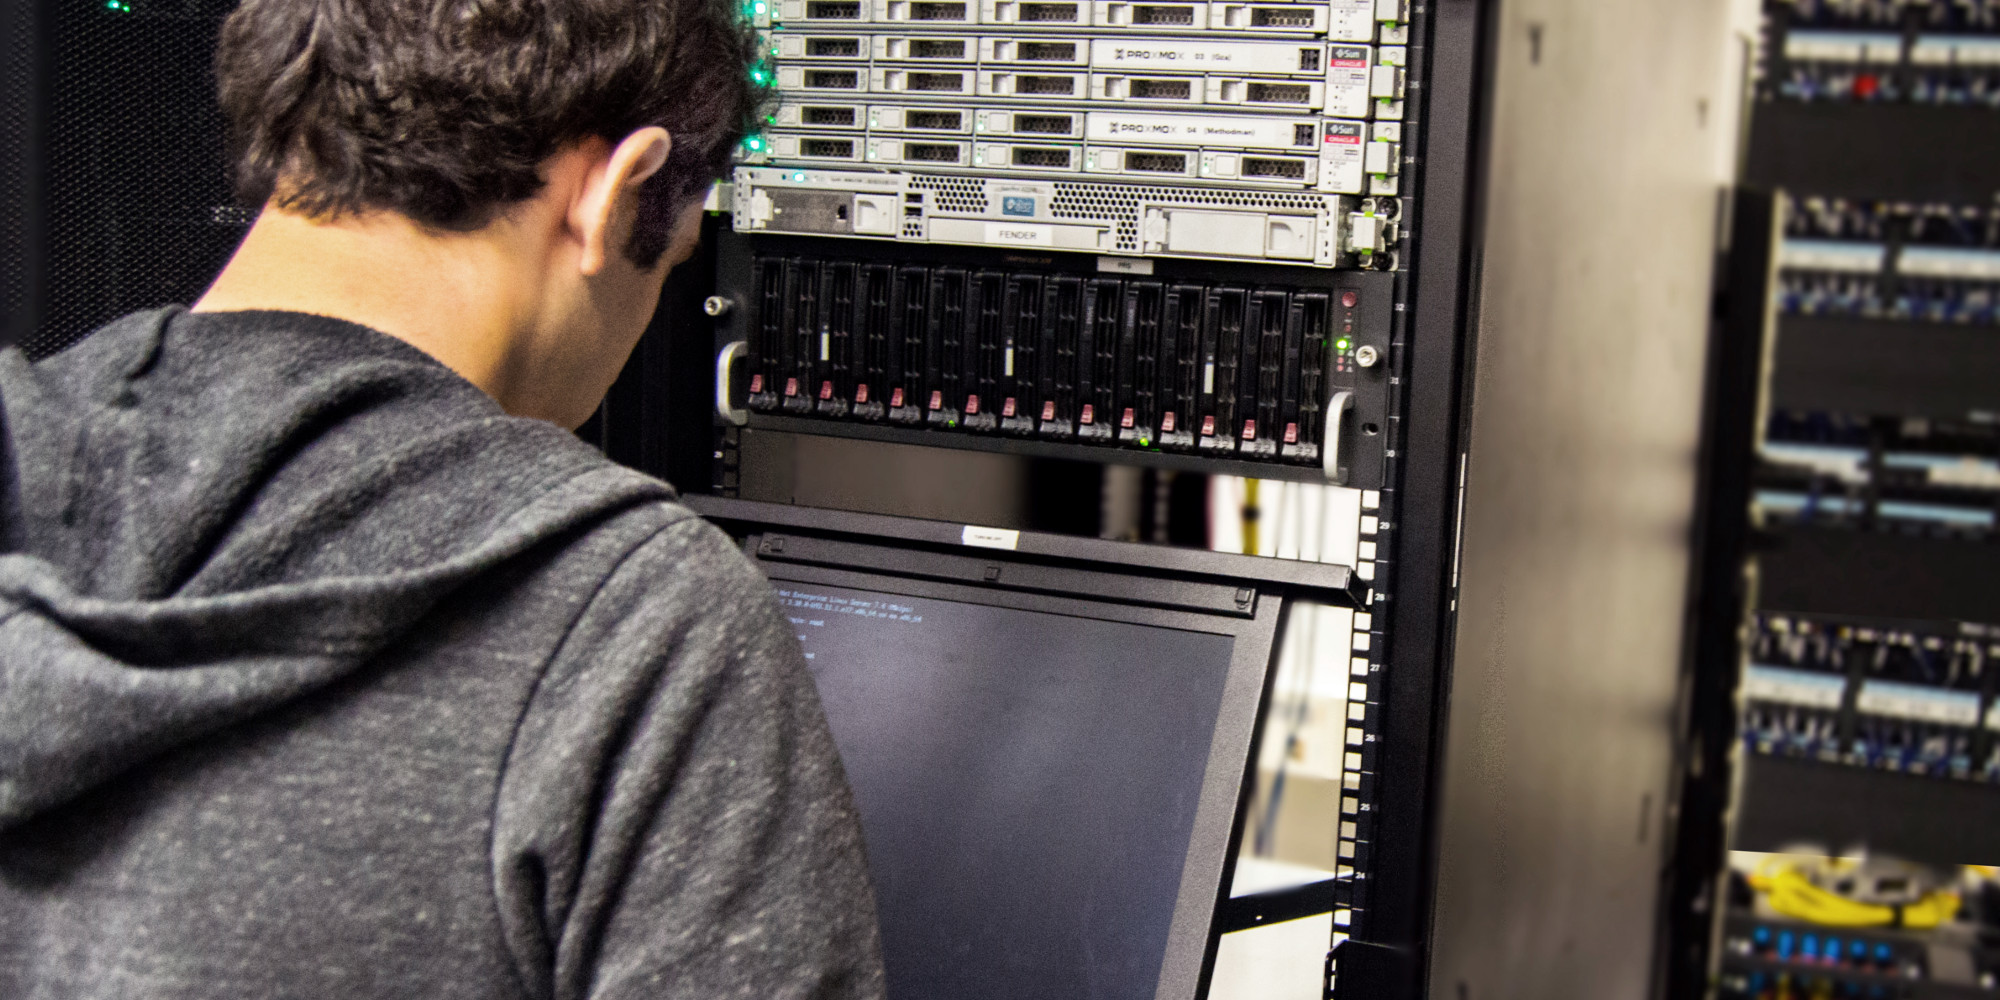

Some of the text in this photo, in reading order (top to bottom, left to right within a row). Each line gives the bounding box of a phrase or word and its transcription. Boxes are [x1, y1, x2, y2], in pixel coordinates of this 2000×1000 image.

[1126, 50, 1184, 60] PROXMOX
[1343, 48, 1360, 58] Sun
[1121, 123, 1177, 134] PROXMOX
[1338, 124, 1354, 134] Sun
[999, 230, 1037, 240] FENDER
[1379, 521, 1390, 530] 29
[1374, 592, 1385, 601] 28
[1369, 663, 1380, 672] 27
[1365, 734, 1375, 742] 26
[1360, 803, 1370, 811] 25
[1355, 871, 1365, 879] 24
